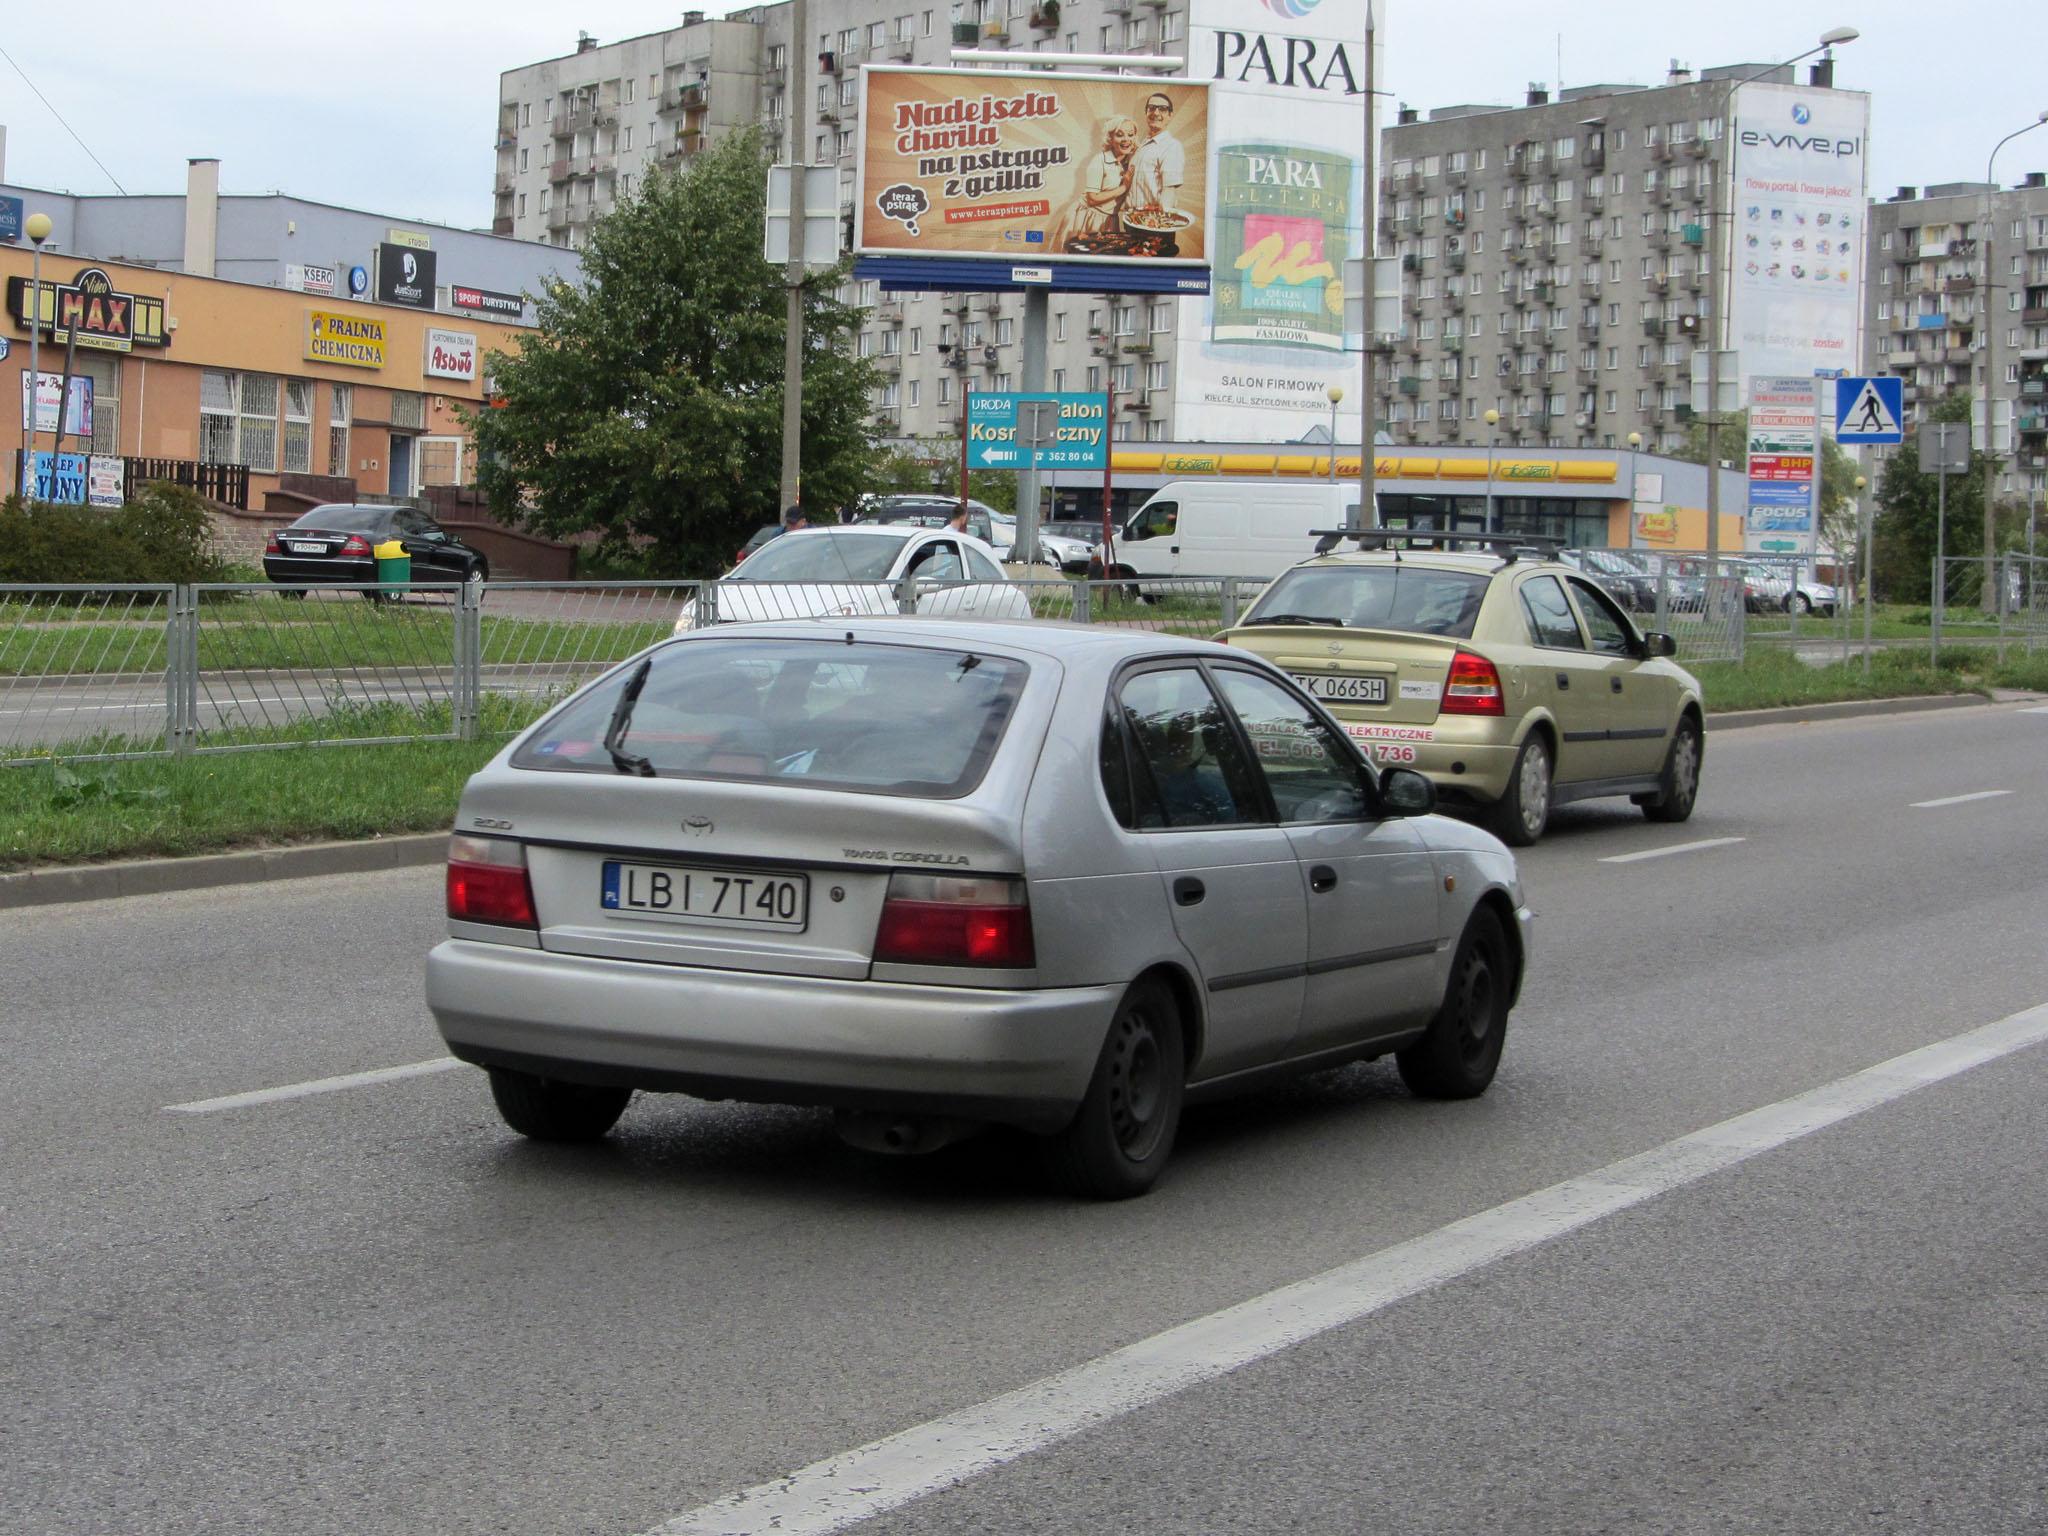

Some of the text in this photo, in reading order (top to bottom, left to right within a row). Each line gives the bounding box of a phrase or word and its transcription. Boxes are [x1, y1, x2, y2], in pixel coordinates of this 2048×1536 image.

[1213, 30, 1358, 93] PARA
[897, 93, 1059, 129] Nadejszła
[898, 126, 1000, 153] chwila
[1741, 131, 1860, 158] e-vive.pl
[920, 156, 956, 176] na
[1247, 156, 1322, 189] PARA
[945, 171, 1044, 198] z grilla
[892, 192, 916, 202] teraz
[83, 275, 108, 295] Video
[304, 267, 333, 284] KSERO
[458, 292, 481, 304] SPORT
[482, 296, 521, 312] TURYSTYKA
[64, 293, 128, 334] MAX
[329, 318, 383, 340] PRALNIA
[1255, 328, 1309, 342] FASADOWA
[311, 338, 383, 363] CHEMICZNA
[1221, 375, 1325, 392] SALON FIRMOWY
[972, 399, 1011, 410] URODA
[1049, 452, 1094, 462] 362 80 04
[1781, 458, 1812, 468] BHP
[1751, 506, 1808, 518] FOCUS
[1326, 678, 1382, 699] 0665H
[1377, 745, 1415, 762] 736
[842, 848, 970, 866] TOYOTA COROLLA
[605, 891, 618, 902] PL
[628, 869, 797, 919] LBI 7T40
